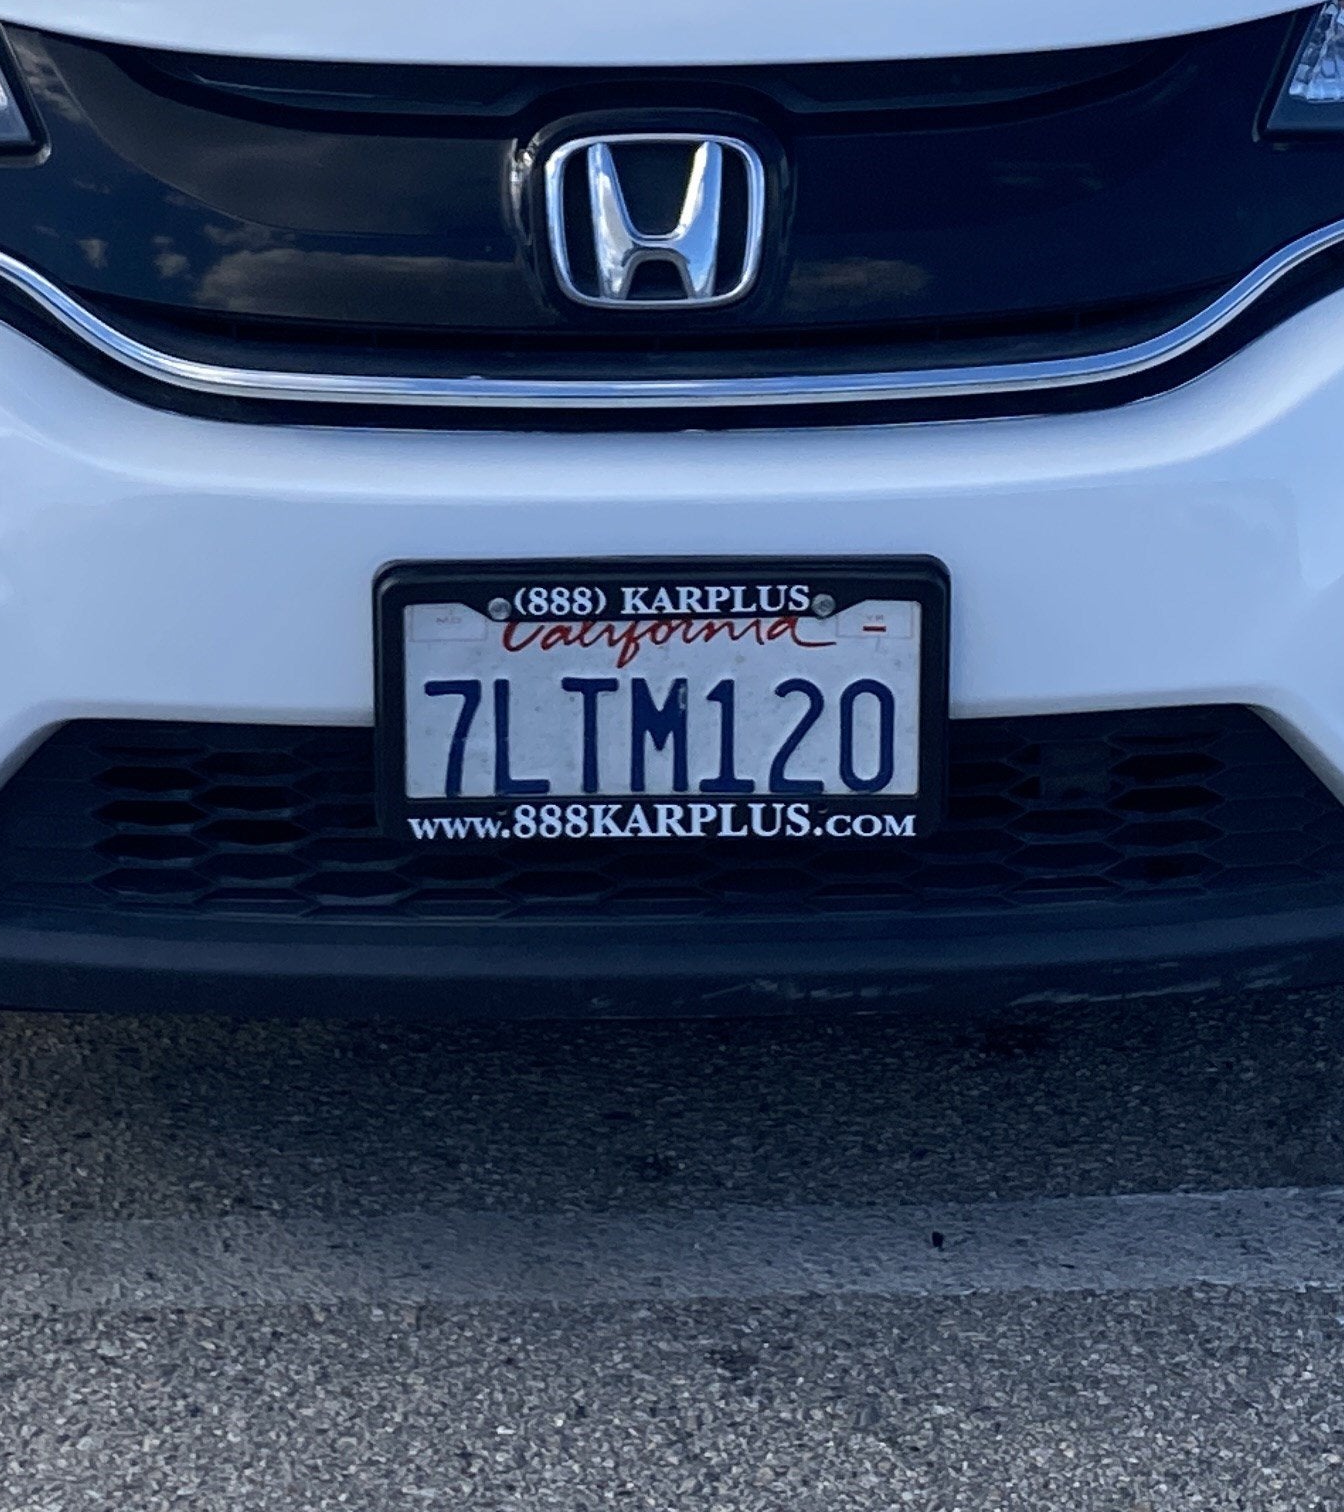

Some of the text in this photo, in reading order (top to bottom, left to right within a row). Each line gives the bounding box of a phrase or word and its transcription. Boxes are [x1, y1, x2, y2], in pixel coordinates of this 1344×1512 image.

[513, 584, 810, 616] (888) KARPLUS
[502, 615, 837, 669] California
[424, 677, 895, 798] 7LTM120
